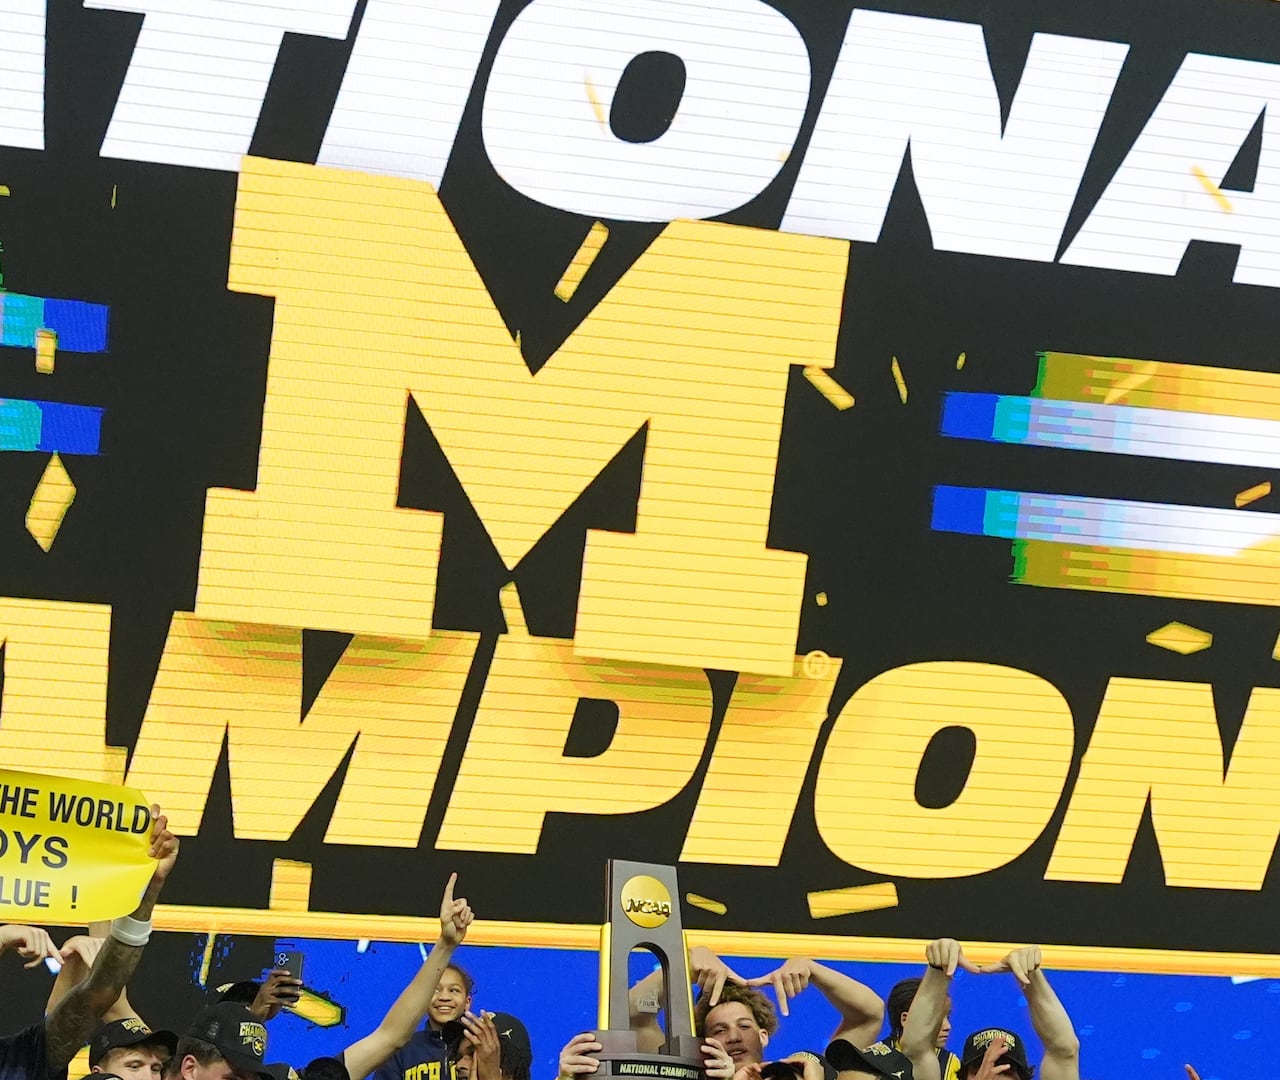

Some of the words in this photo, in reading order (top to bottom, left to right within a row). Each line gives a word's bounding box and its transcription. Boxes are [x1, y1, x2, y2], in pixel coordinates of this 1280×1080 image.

[196, 155, 849, 677] M
[48, 792, 151, 836] WORLD
[70, 885, 79, 910] !
[625, 896, 672, 918] NCAA
[619, 1063, 659, 1076] NATIONAL
[660, 1066, 699, 1080] CHAMPION
